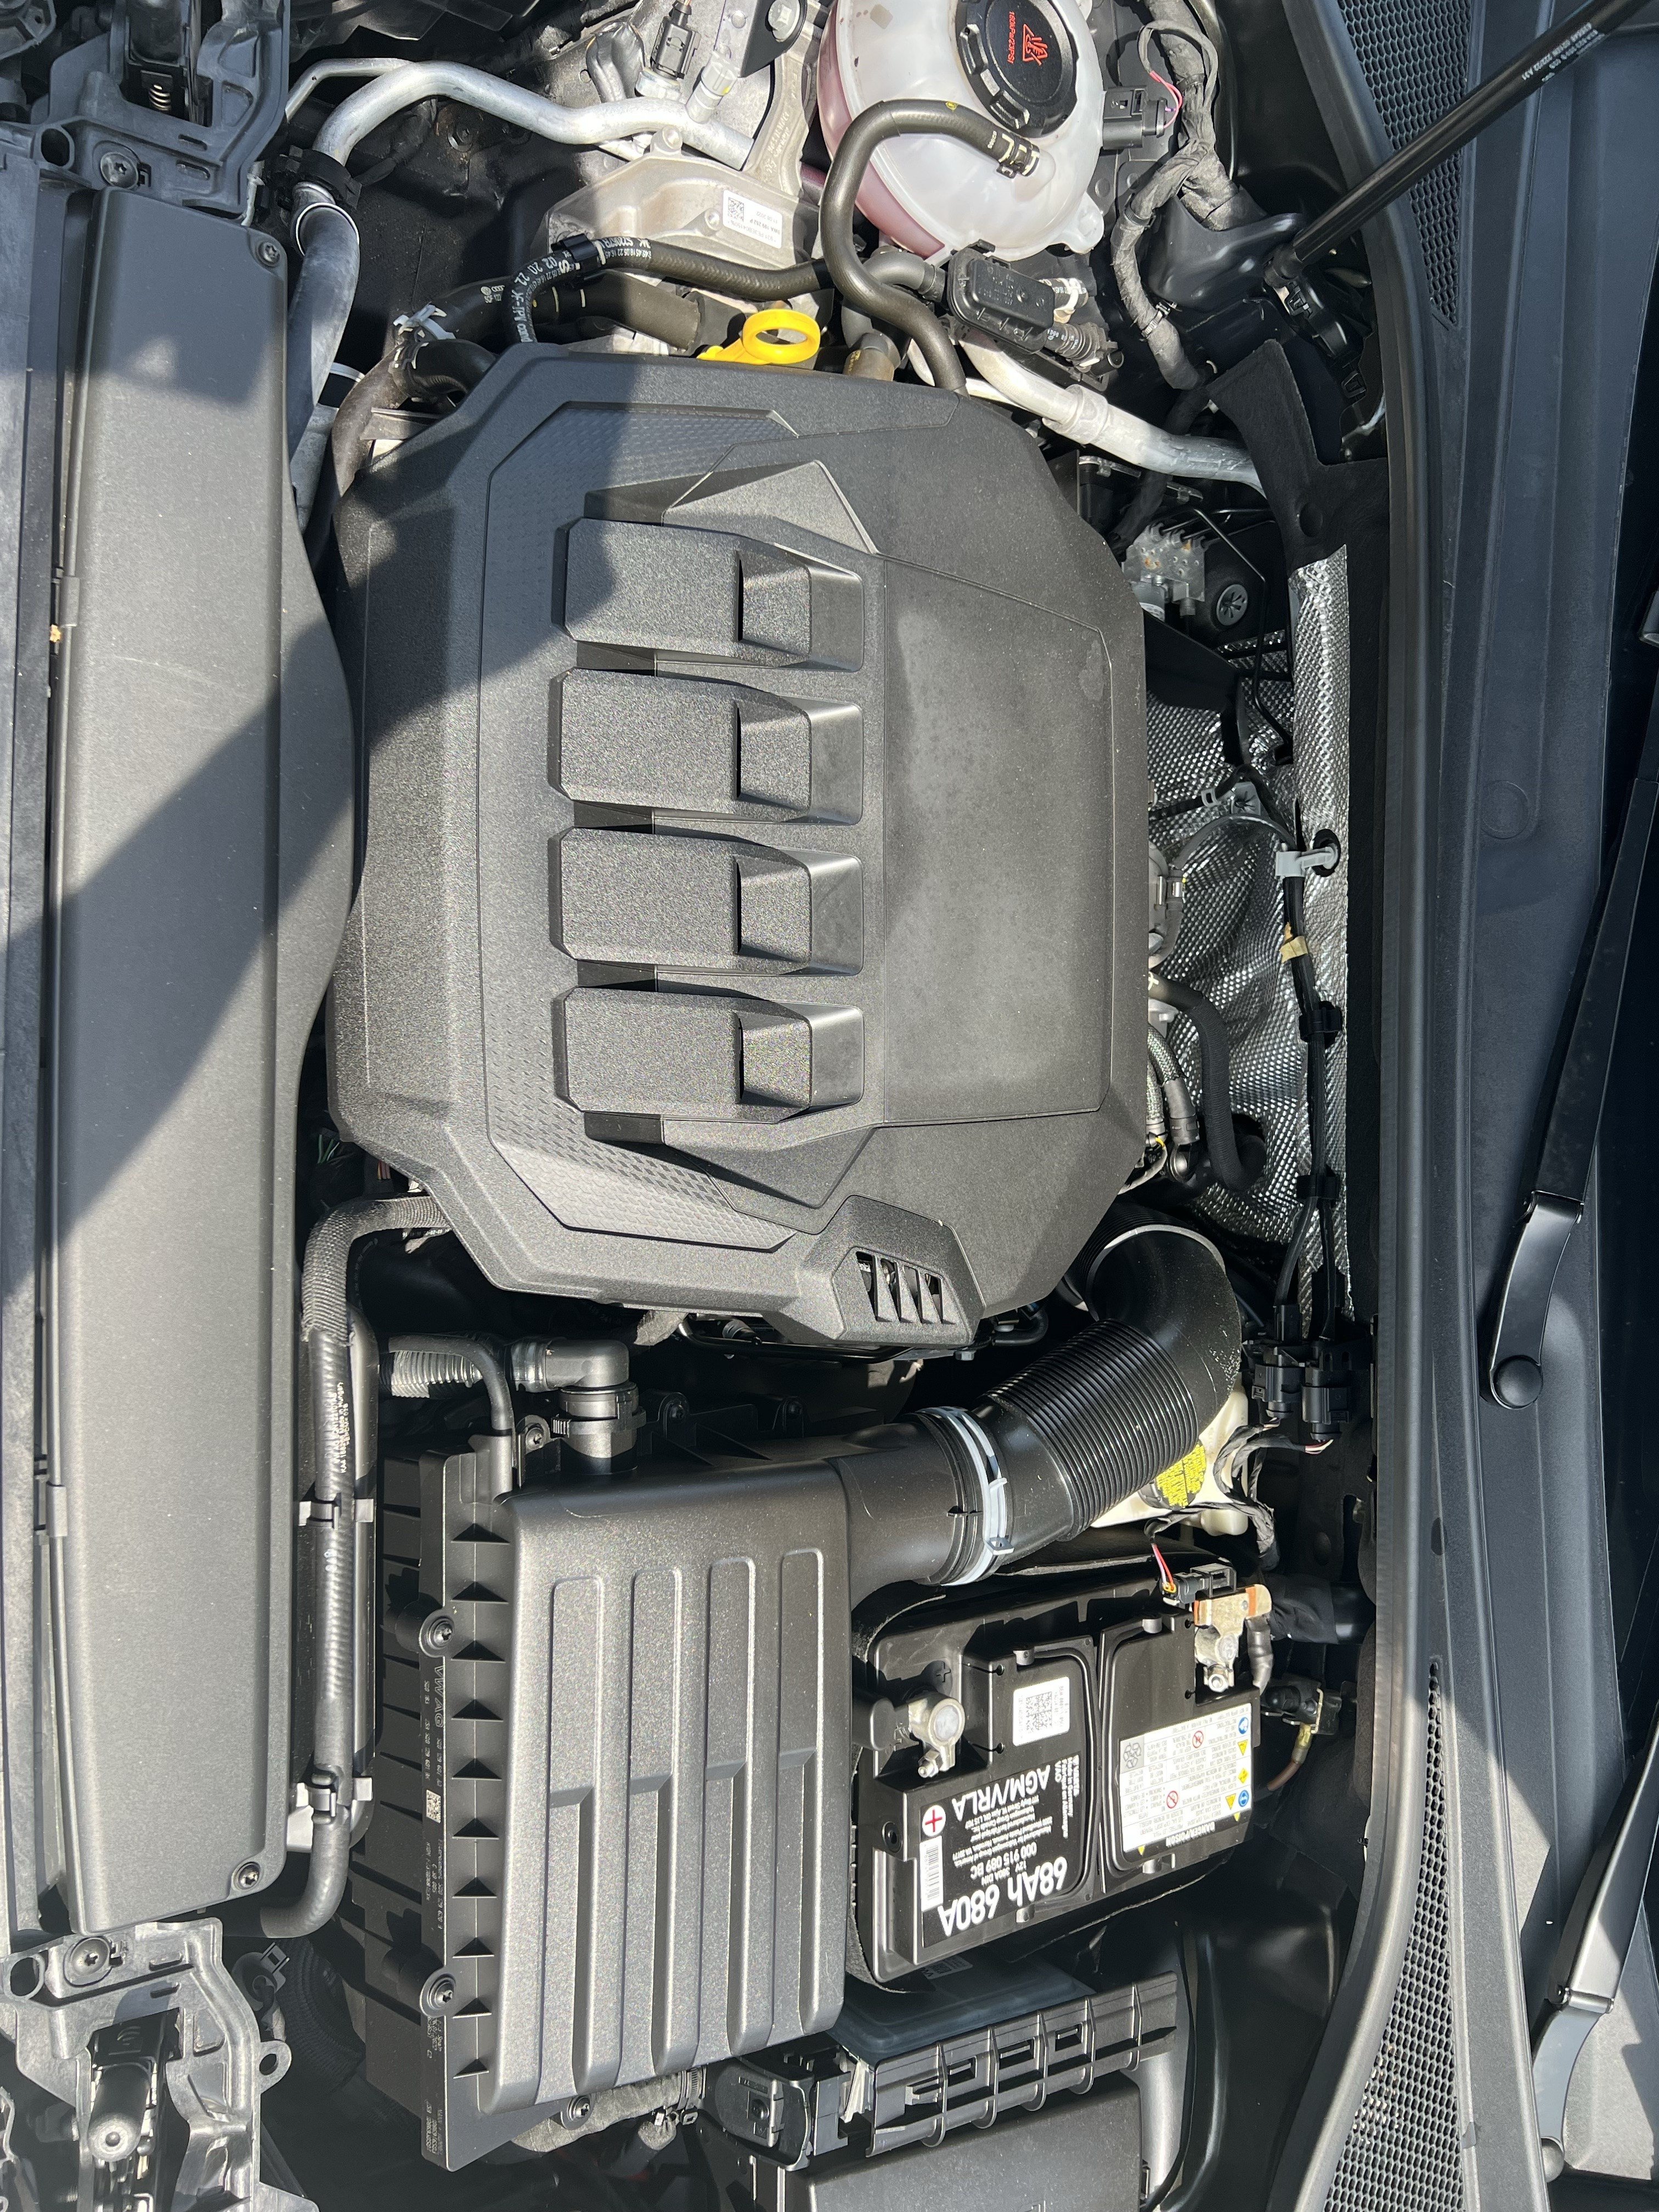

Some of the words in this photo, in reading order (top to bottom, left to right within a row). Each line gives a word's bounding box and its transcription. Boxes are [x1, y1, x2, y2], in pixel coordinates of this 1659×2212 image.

[527, 260, 544, 277] 20
[511, 269, 532, 290] 22
[435, 1666, 445, 1696] VW
[434, 1698, 445, 1729] AG
[1068, 1776, 1072, 1784] in
[951, 1764, 1051, 1824] AGM/VRLA
[1062, 1790, 1066, 1800] en
[1164, 1820, 1215, 1846] DANGER/POISON
[1003, 1848, 1019, 1867] 915
[1020, 1841, 1036, 1860] 000
[970, 1861, 984, 1880] BC
[985, 1854, 1002, 1874] 089
[1014, 1859, 1026, 1874] 12V
[981, 1872, 994, 1887] DIN
[1007, 1856, 1067, 1907] 68Ah
[938, 1884, 1000, 1937] 680A
